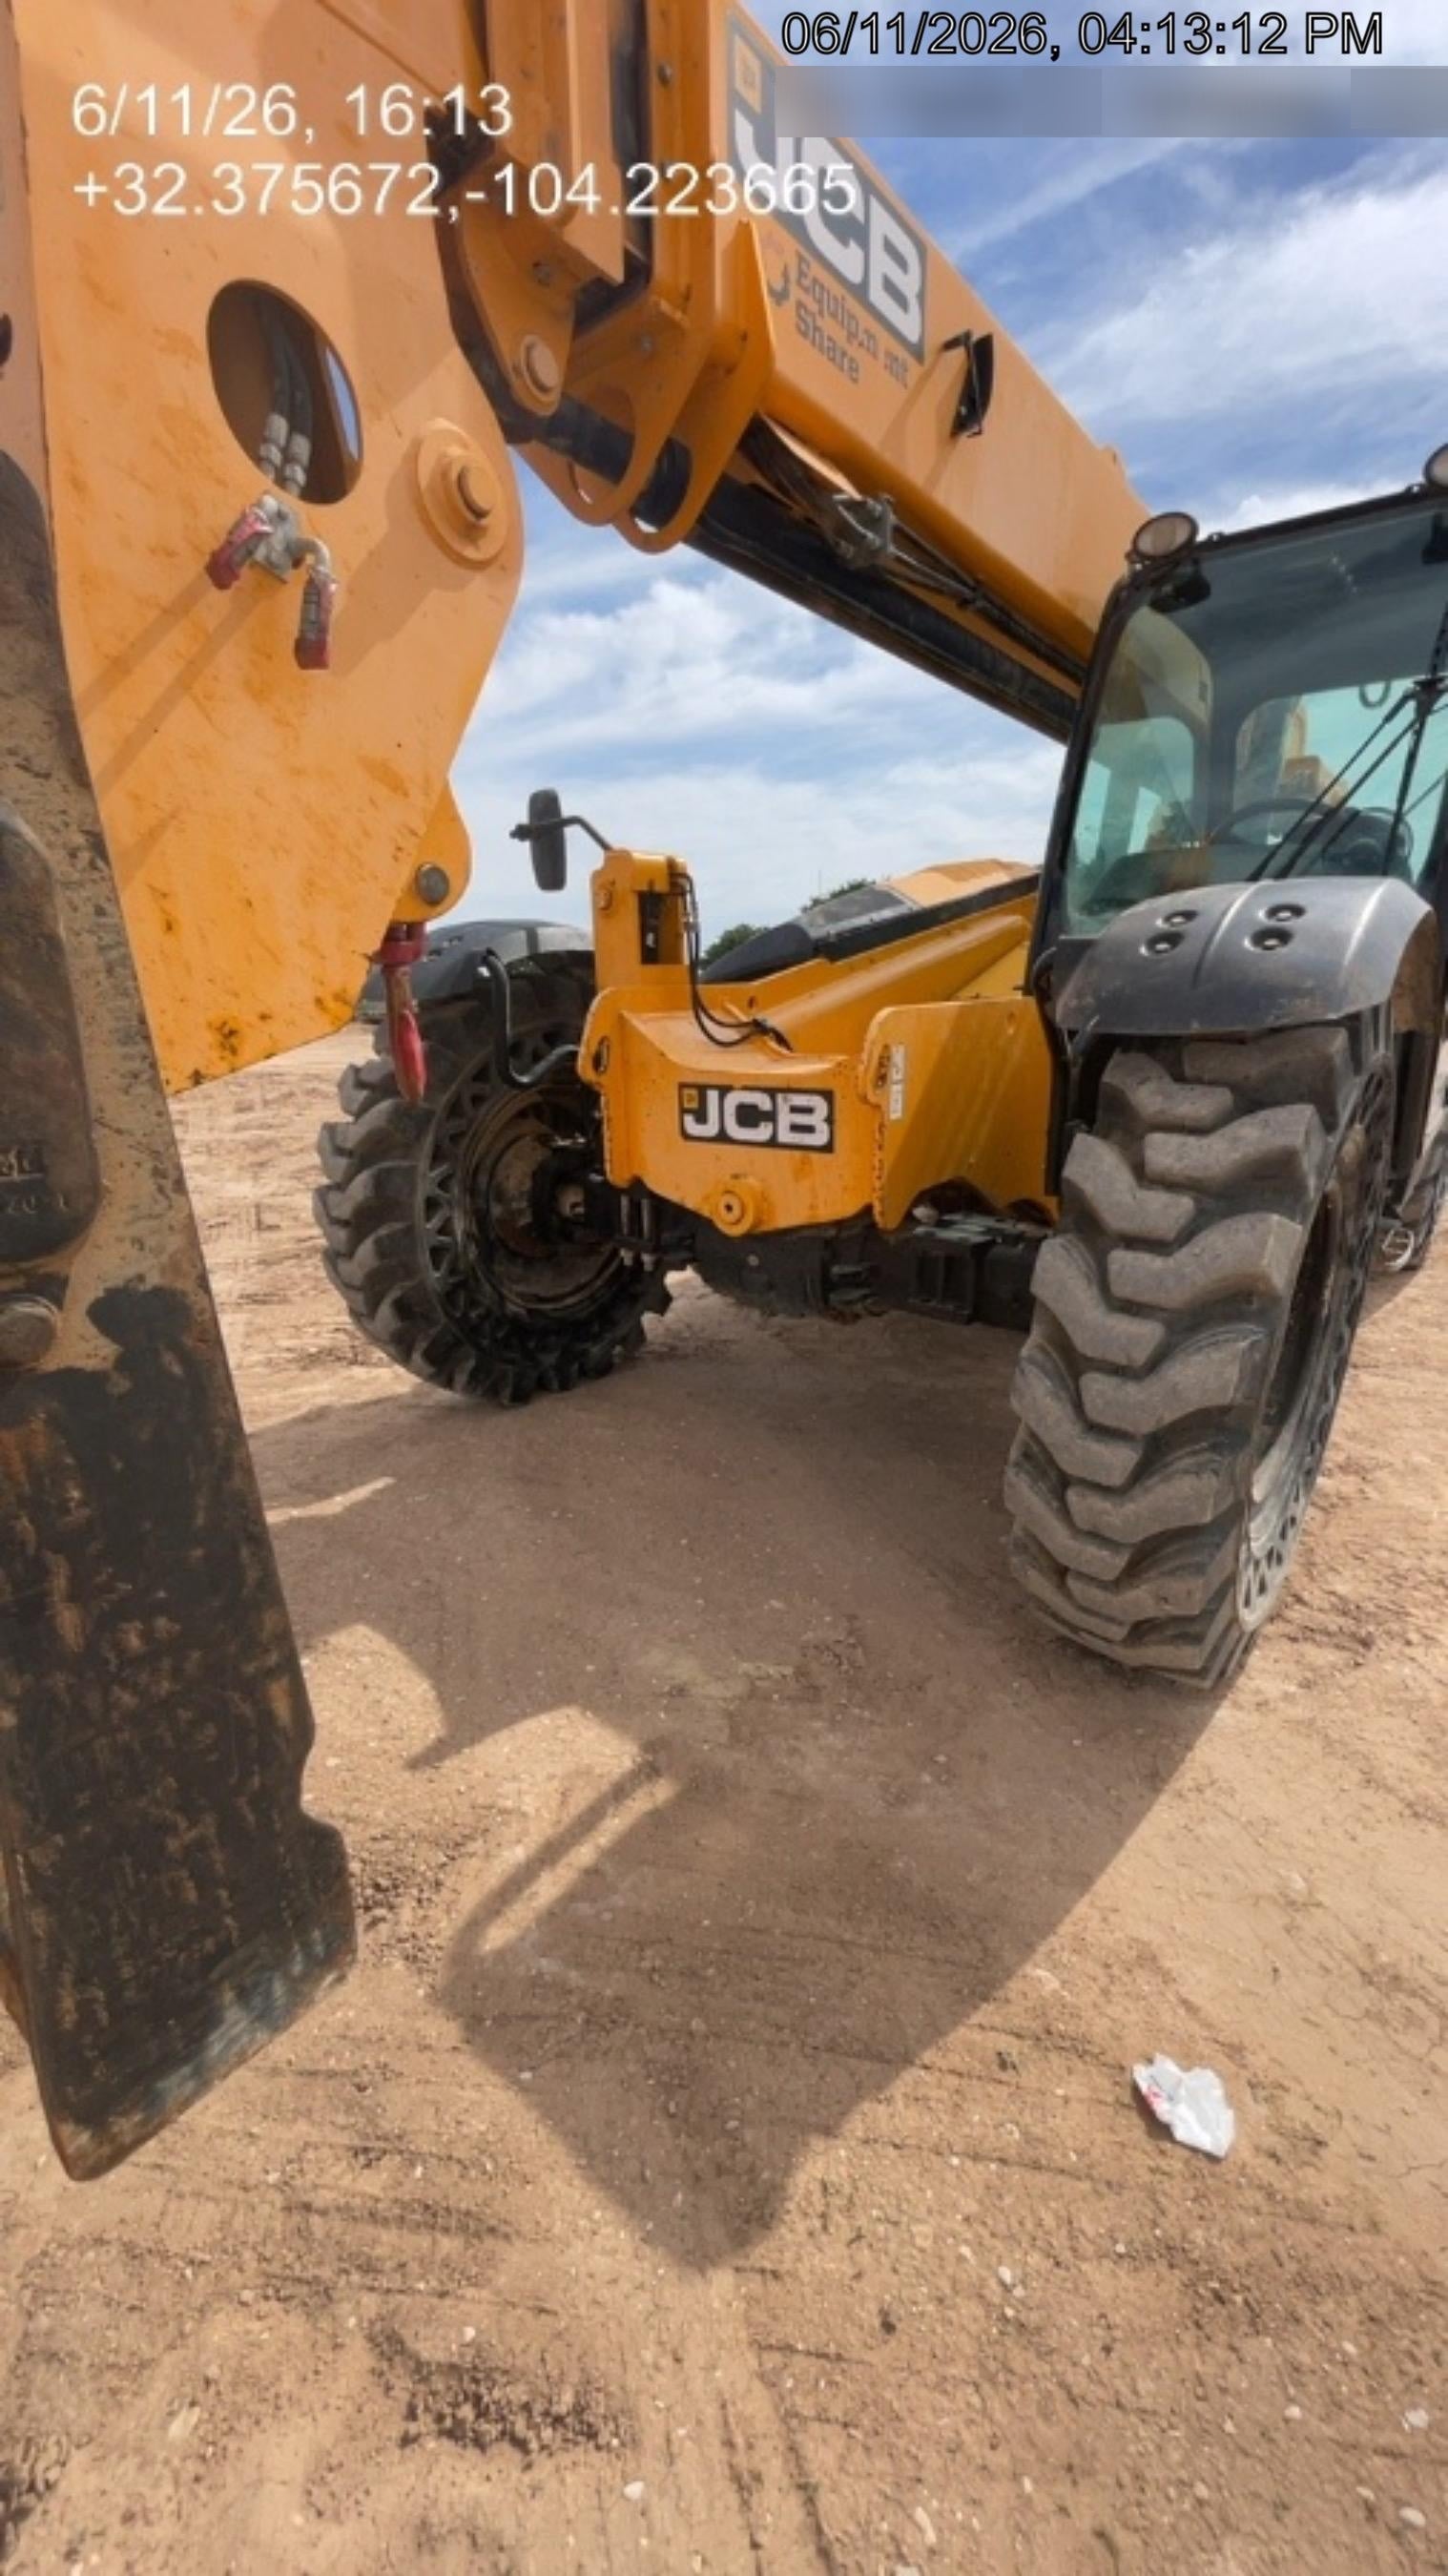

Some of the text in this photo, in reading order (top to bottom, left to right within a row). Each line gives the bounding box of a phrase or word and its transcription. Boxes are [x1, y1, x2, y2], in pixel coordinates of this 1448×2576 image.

[734, 108, 922, 345] JCB
[796, 250, 908, 390] Equipmnt
[796, 299, 859, 384] Share
[682, 1089, 831, 1147] JCB
